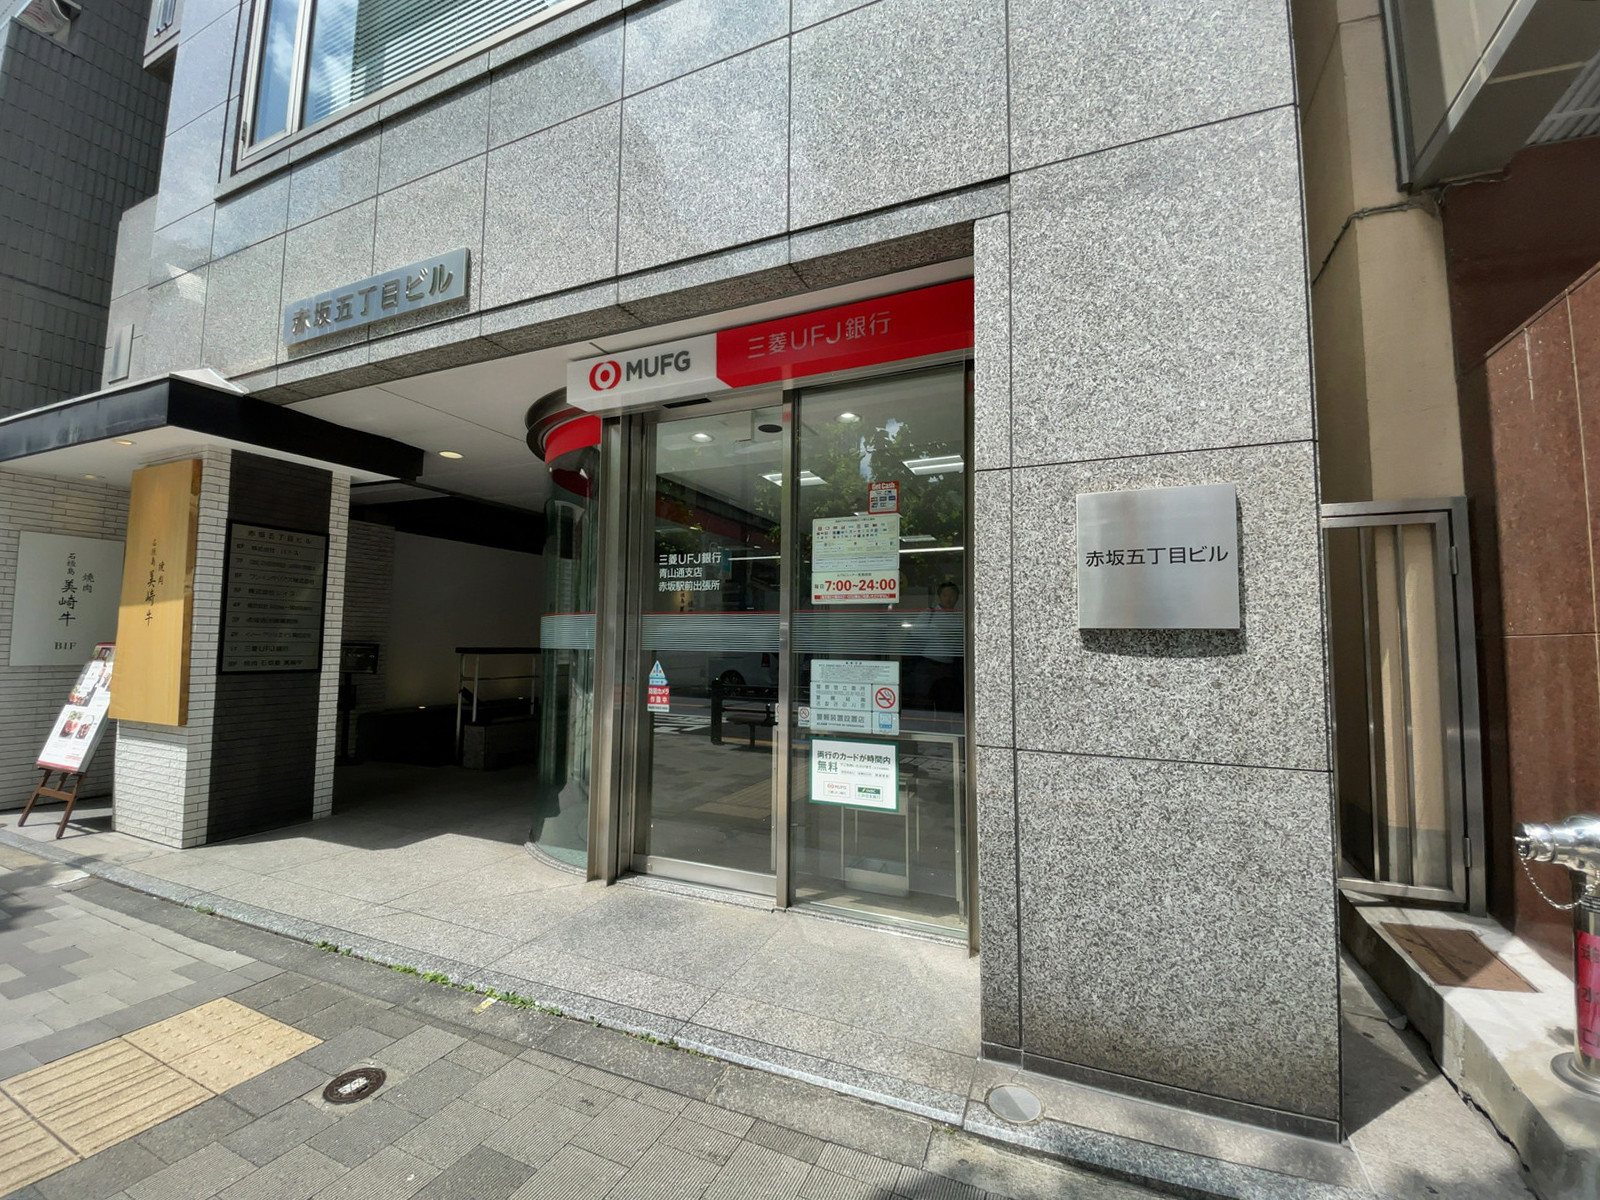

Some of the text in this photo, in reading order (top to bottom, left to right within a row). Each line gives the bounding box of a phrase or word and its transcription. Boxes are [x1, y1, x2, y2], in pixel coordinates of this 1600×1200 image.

[292, 263, 453, 336] 赤坂五丁目ビル
[747, 310, 891, 359] 三菱UFJ銀行
[625, 351, 691, 382] MUFG
[658, 552, 722, 566] 三菱UFJ銀行
[1085, 546, 1229, 568] 赤坂五丁目ビル
[659, 567, 703, 579] 青山通支店
[658, 580, 721, 592] 赤坂駅前出張所
[825, 579, 897, 592] 7:00~24:00
[817, 750, 891, 764] 両行のカードが時間内
[817, 760, 838, 772] 無料
